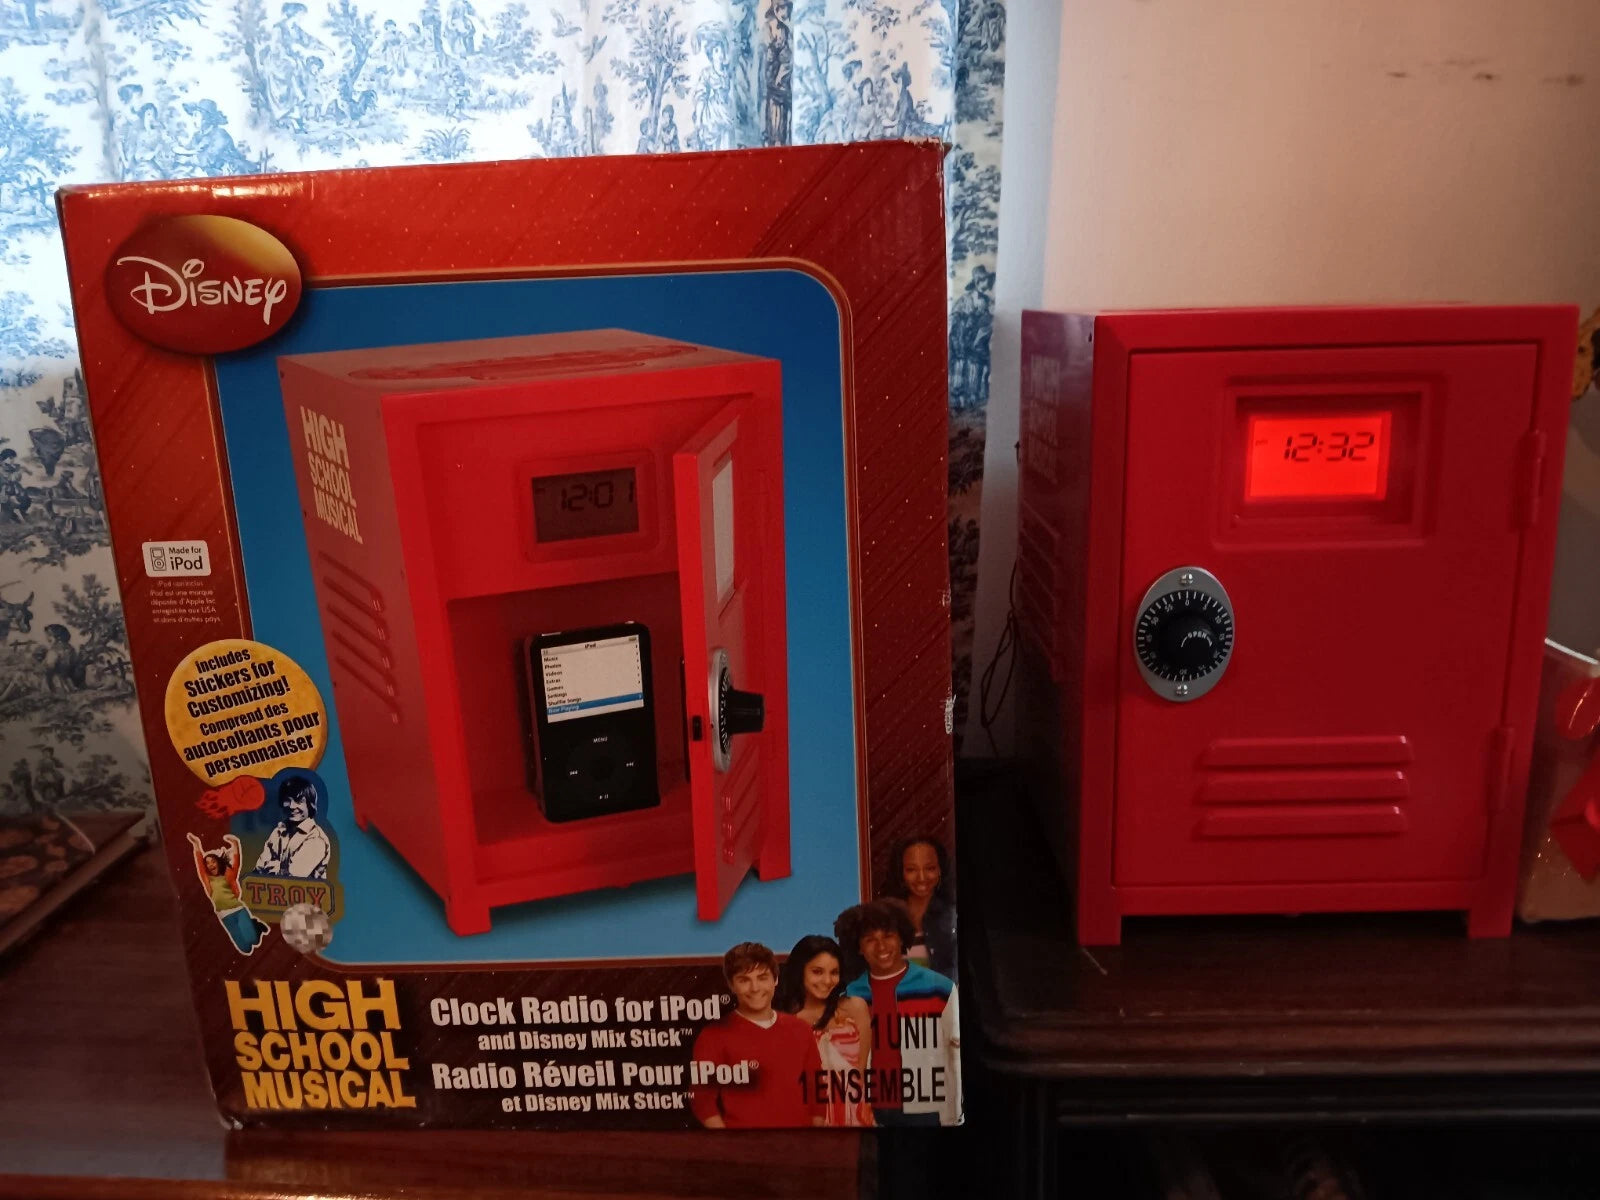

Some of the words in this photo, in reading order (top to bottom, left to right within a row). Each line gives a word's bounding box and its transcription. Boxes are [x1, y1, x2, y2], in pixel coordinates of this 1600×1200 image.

[117, 256, 287, 325] Disney
[301, 405, 350, 469] HIGH
[1284, 431, 1375, 462] 12:32
[308, 451, 357, 509] SCHOOL
[561, 480, 634, 512] 12:01
[314, 486, 363, 544] MUSICAL
[170, 556, 203, 571] iPod
[191, 546, 202, 554] for
[1187, 630, 1208, 640] OPEN
[184, 666, 251, 698] Stickers
[251, 660, 276, 679] for
[195, 649, 250, 674] includes
[186, 675, 291, 718] Customizing!
[183, 722, 282, 762] autocollants
[281, 711, 320, 736] pour
[199, 707, 264, 736] Comprend
[264, 702, 289, 718] des
[204, 734, 314, 778] personnaliser
[246, 882, 326, 909] TROY
[225, 979, 401, 1030] HIGH
[430, 997, 516, 1026] Clock
[521, 995, 608, 1025] Radio
[615, 996, 654, 1022] for
[477, 1031, 515, 1051] and
[519, 1030, 587, 1051] Disney
[591, 1030, 627, 1048] Mix
[871, 1013, 880, 1049] 1
[888, 1011, 942, 1049] UNIT
[234, 1031, 410, 1071] SCHOOL
[241, 1070, 417, 1109] MUSICAL
[431, 1062, 517, 1089] Radio
[522, 1059, 616, 1088] Réveil
[621, 1061, 684, 1086] Pour
[798, 1071, 808, 1104] 1
[815, 1066, 946, 1104] ENSEMBLE
[501, 1095, 521, 1112] et
[525, 1093, 591, 1112] Disney
[595, 1093, 631, 1110] Mix
